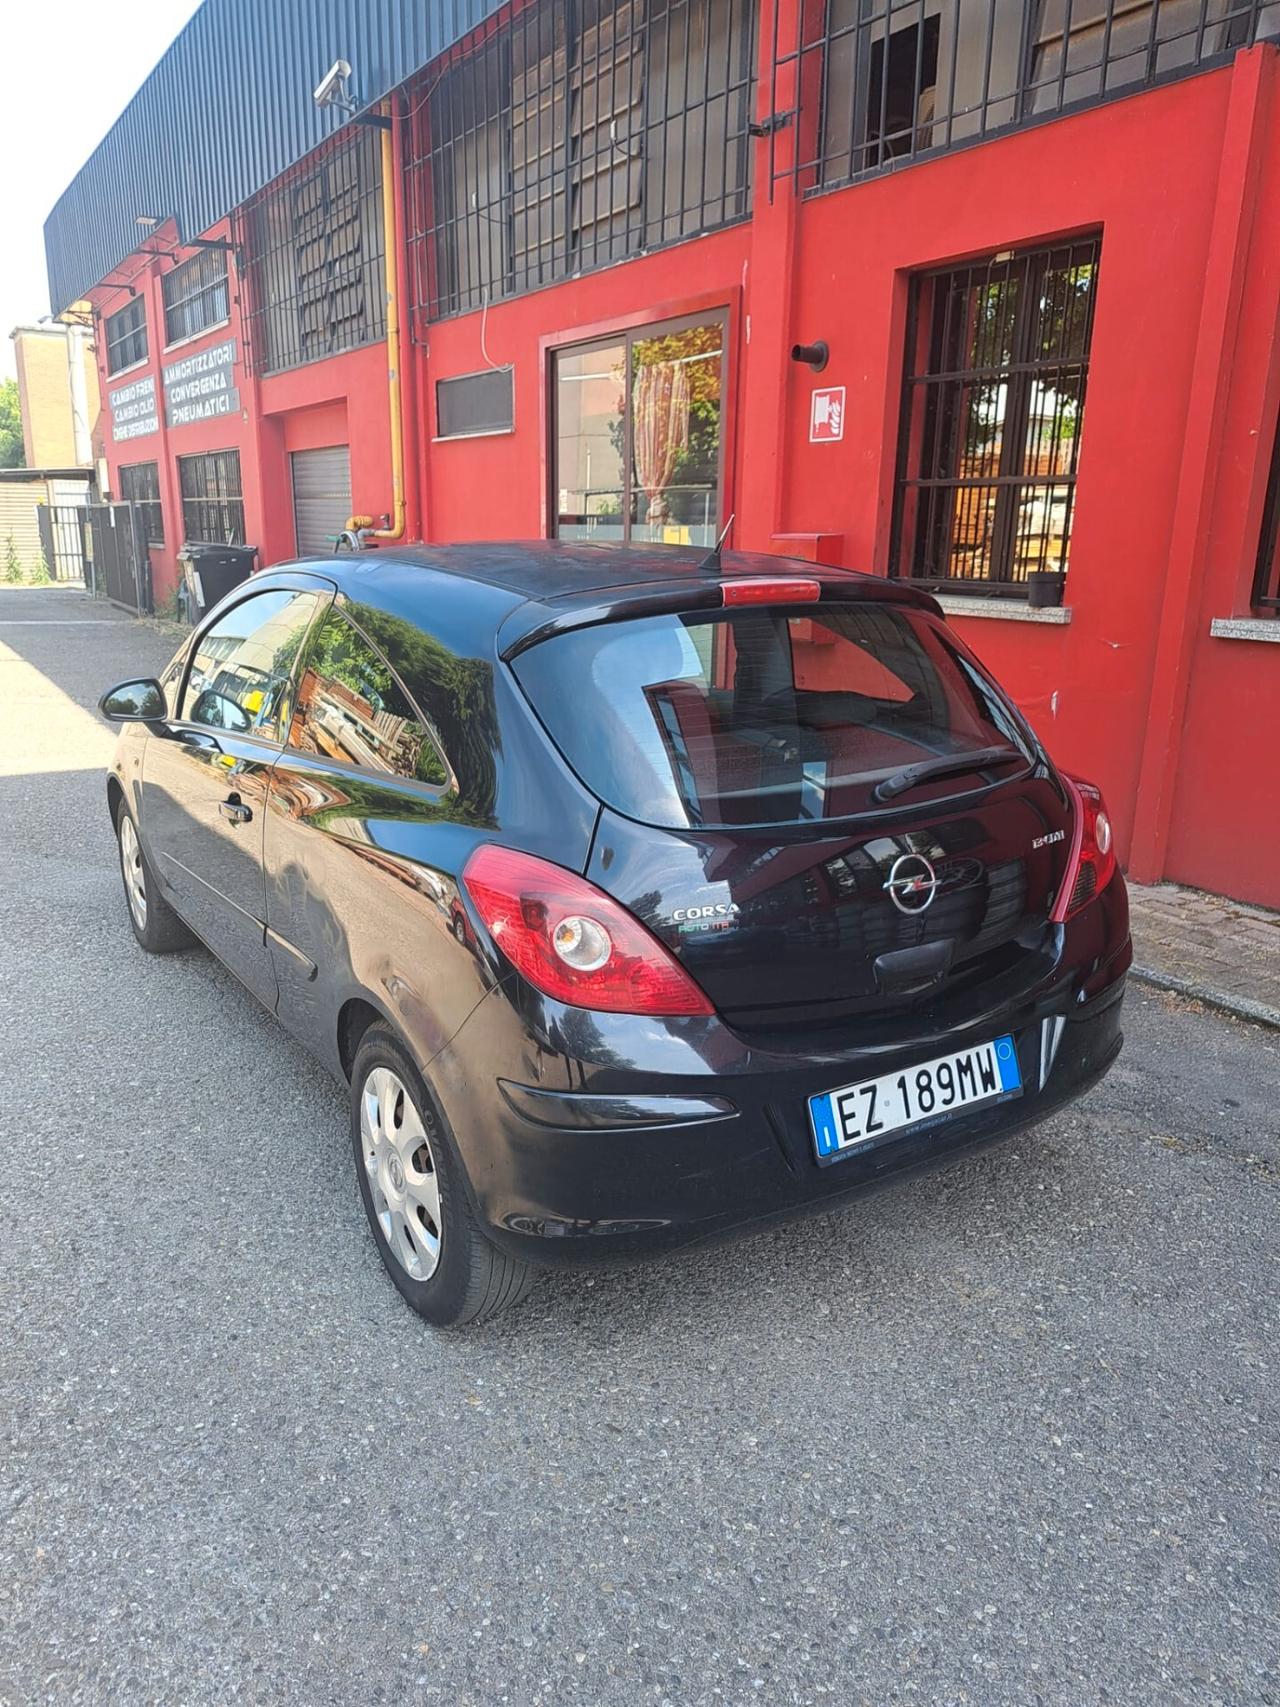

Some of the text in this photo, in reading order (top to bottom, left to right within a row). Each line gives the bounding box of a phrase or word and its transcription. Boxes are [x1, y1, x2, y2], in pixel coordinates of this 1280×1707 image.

[164, 343, 233, 385] AMMORTIZZATORI
[111, 386, 136, 407] CAMBIO
[170, 371, 228, 403] CONVERGENZA
[114, 397, 155, 422] CAMBIO OLIO
[172, 394, 230, 425] PNEUMATICI
[673, 903, 741, 921] CORSA
[836, 1047, 997, 1142] EZ 189MW
